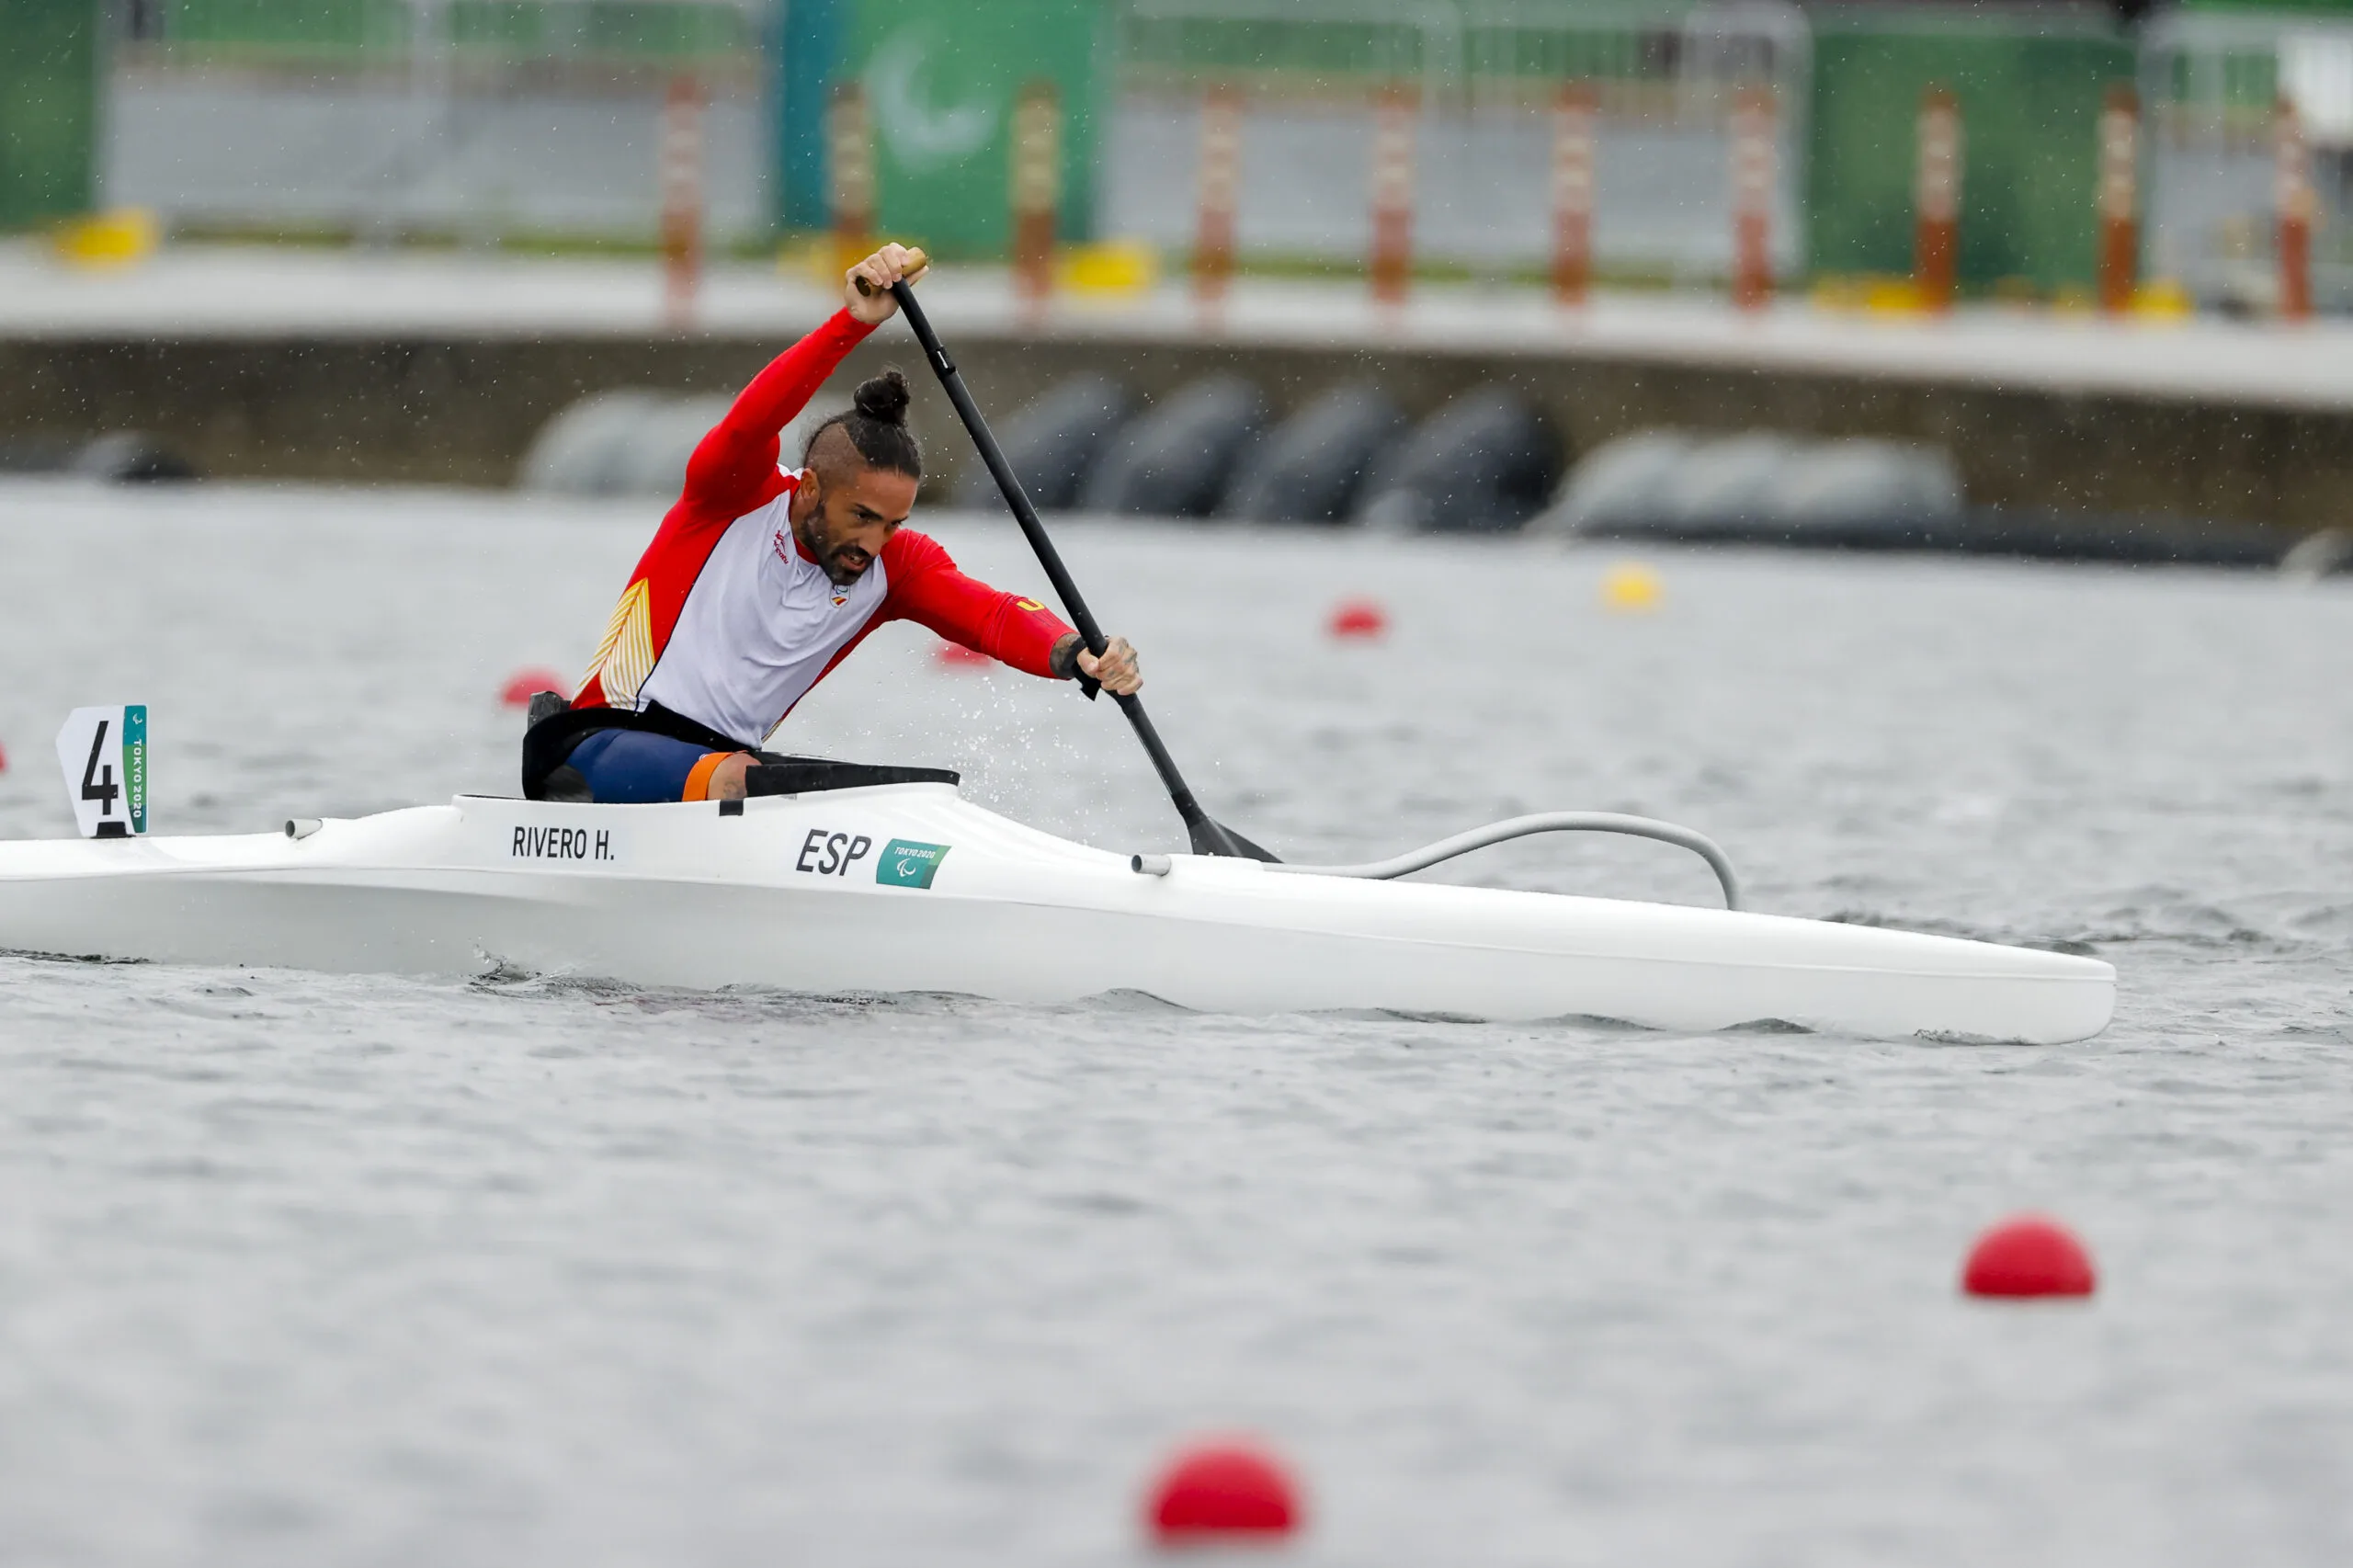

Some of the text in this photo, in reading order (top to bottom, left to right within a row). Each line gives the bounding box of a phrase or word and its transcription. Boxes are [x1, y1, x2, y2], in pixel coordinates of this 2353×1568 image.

[82, 721, 119, 815] 4
[133, 738, 142, 818] TOKYO 2020
[512, 825, 614, 860] RIVERO H.
[796, 828, 872, 876] ESP
[894, 846, 936, 858] TOKYO 2020
